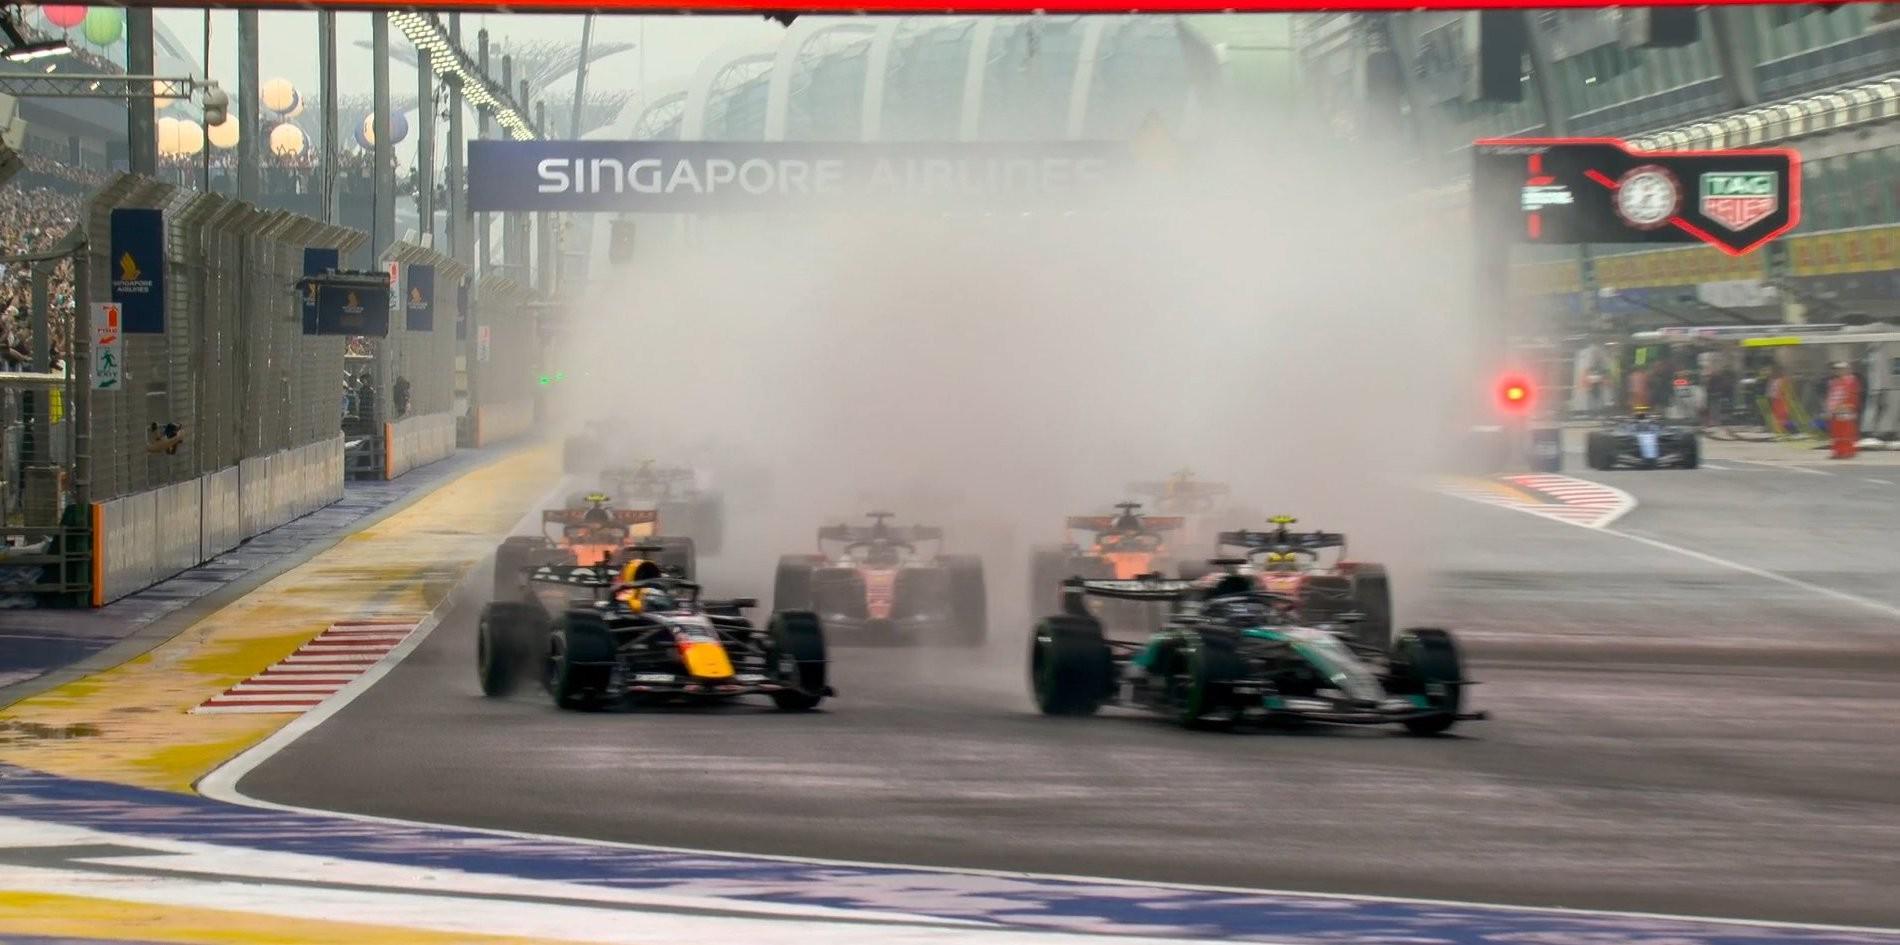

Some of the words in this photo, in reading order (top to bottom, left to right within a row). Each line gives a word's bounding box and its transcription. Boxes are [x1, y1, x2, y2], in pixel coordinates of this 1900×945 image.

[537, 157, 841, 194] SINGAPORE
[867, 157, 1106, 194] AIRLINES
[1705, 175, 1770, 194] TAG
